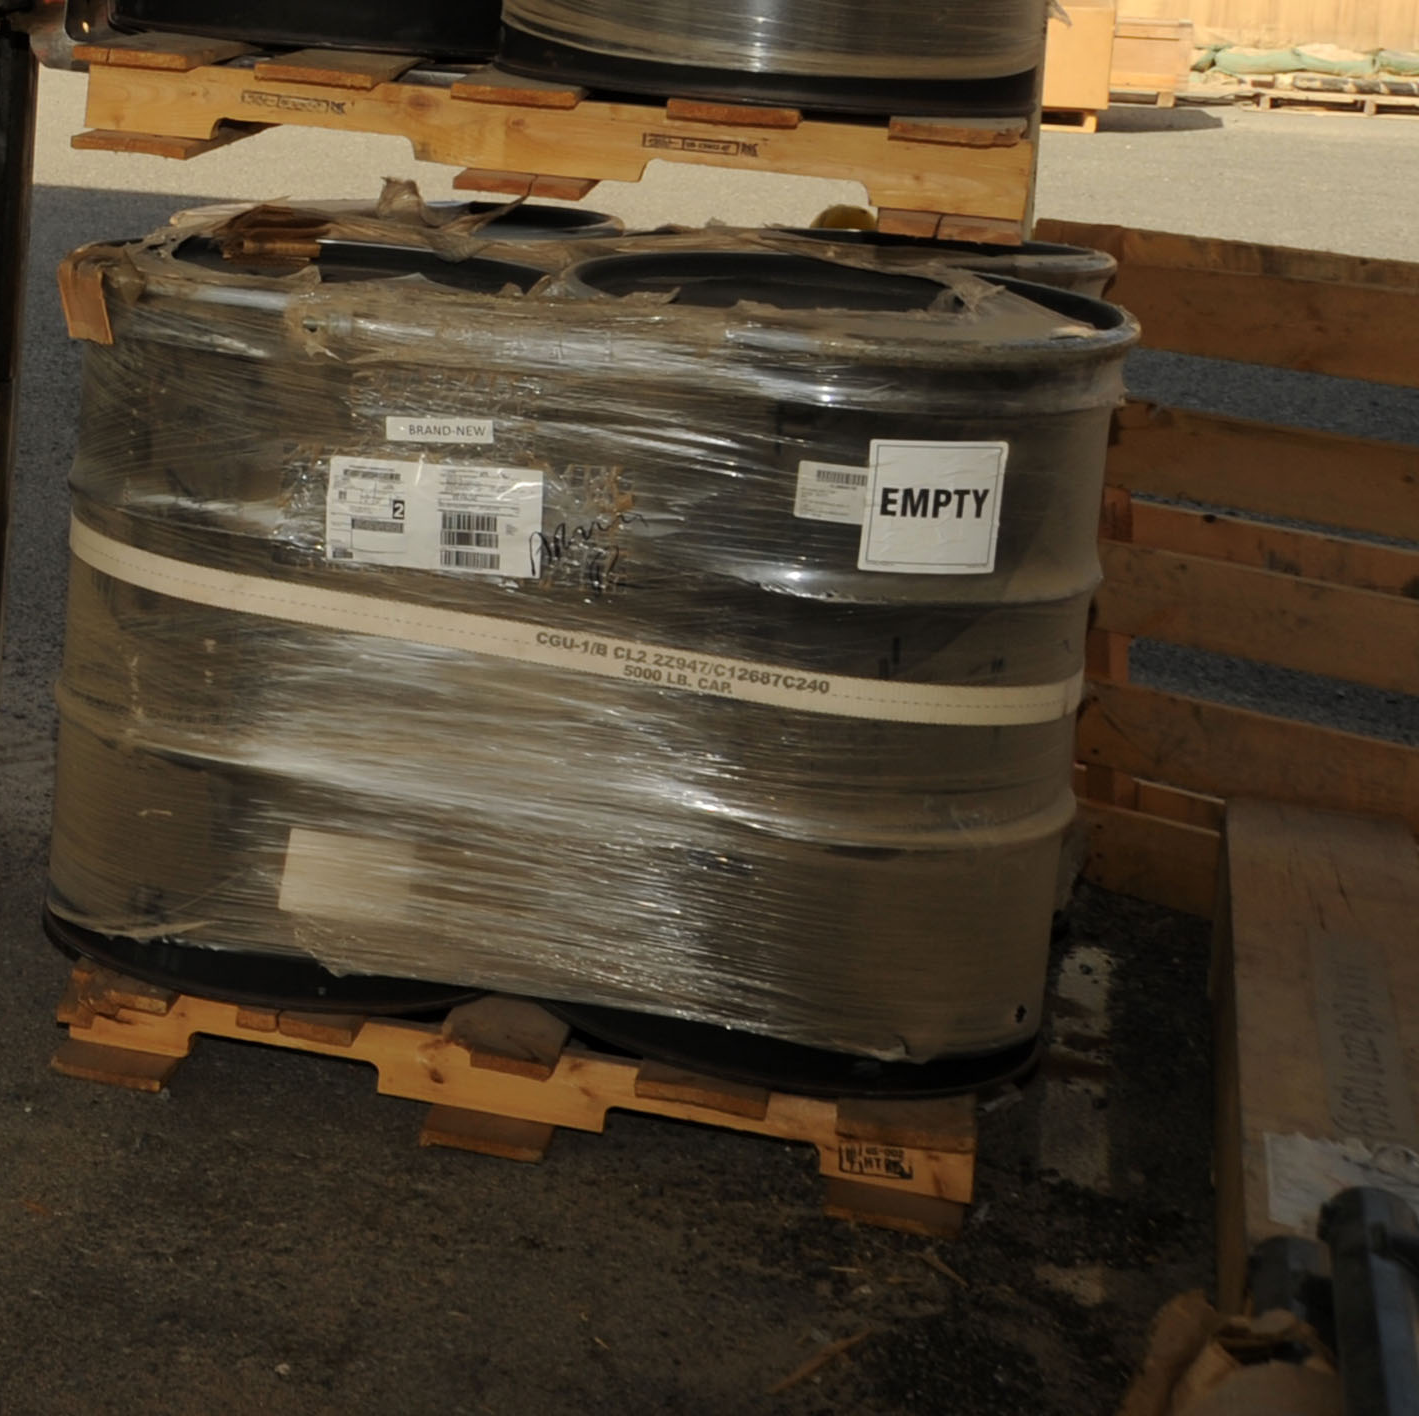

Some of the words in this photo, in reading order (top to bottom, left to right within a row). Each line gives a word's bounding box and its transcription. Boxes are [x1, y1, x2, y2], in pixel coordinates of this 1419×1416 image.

[408, 424, 486, 437] BRAND-NEW
[393, 500, 404, 519] 2
[879, 486, 990, 519] EMPTY
[535, 631, 609, 658] CGU-1/B
[612, 645, 647, 665] CL2
[623, 664, 662, 682] 5000
[666, 673, 692, 688] LB.
[697, 677, 733, 695] CAP.
